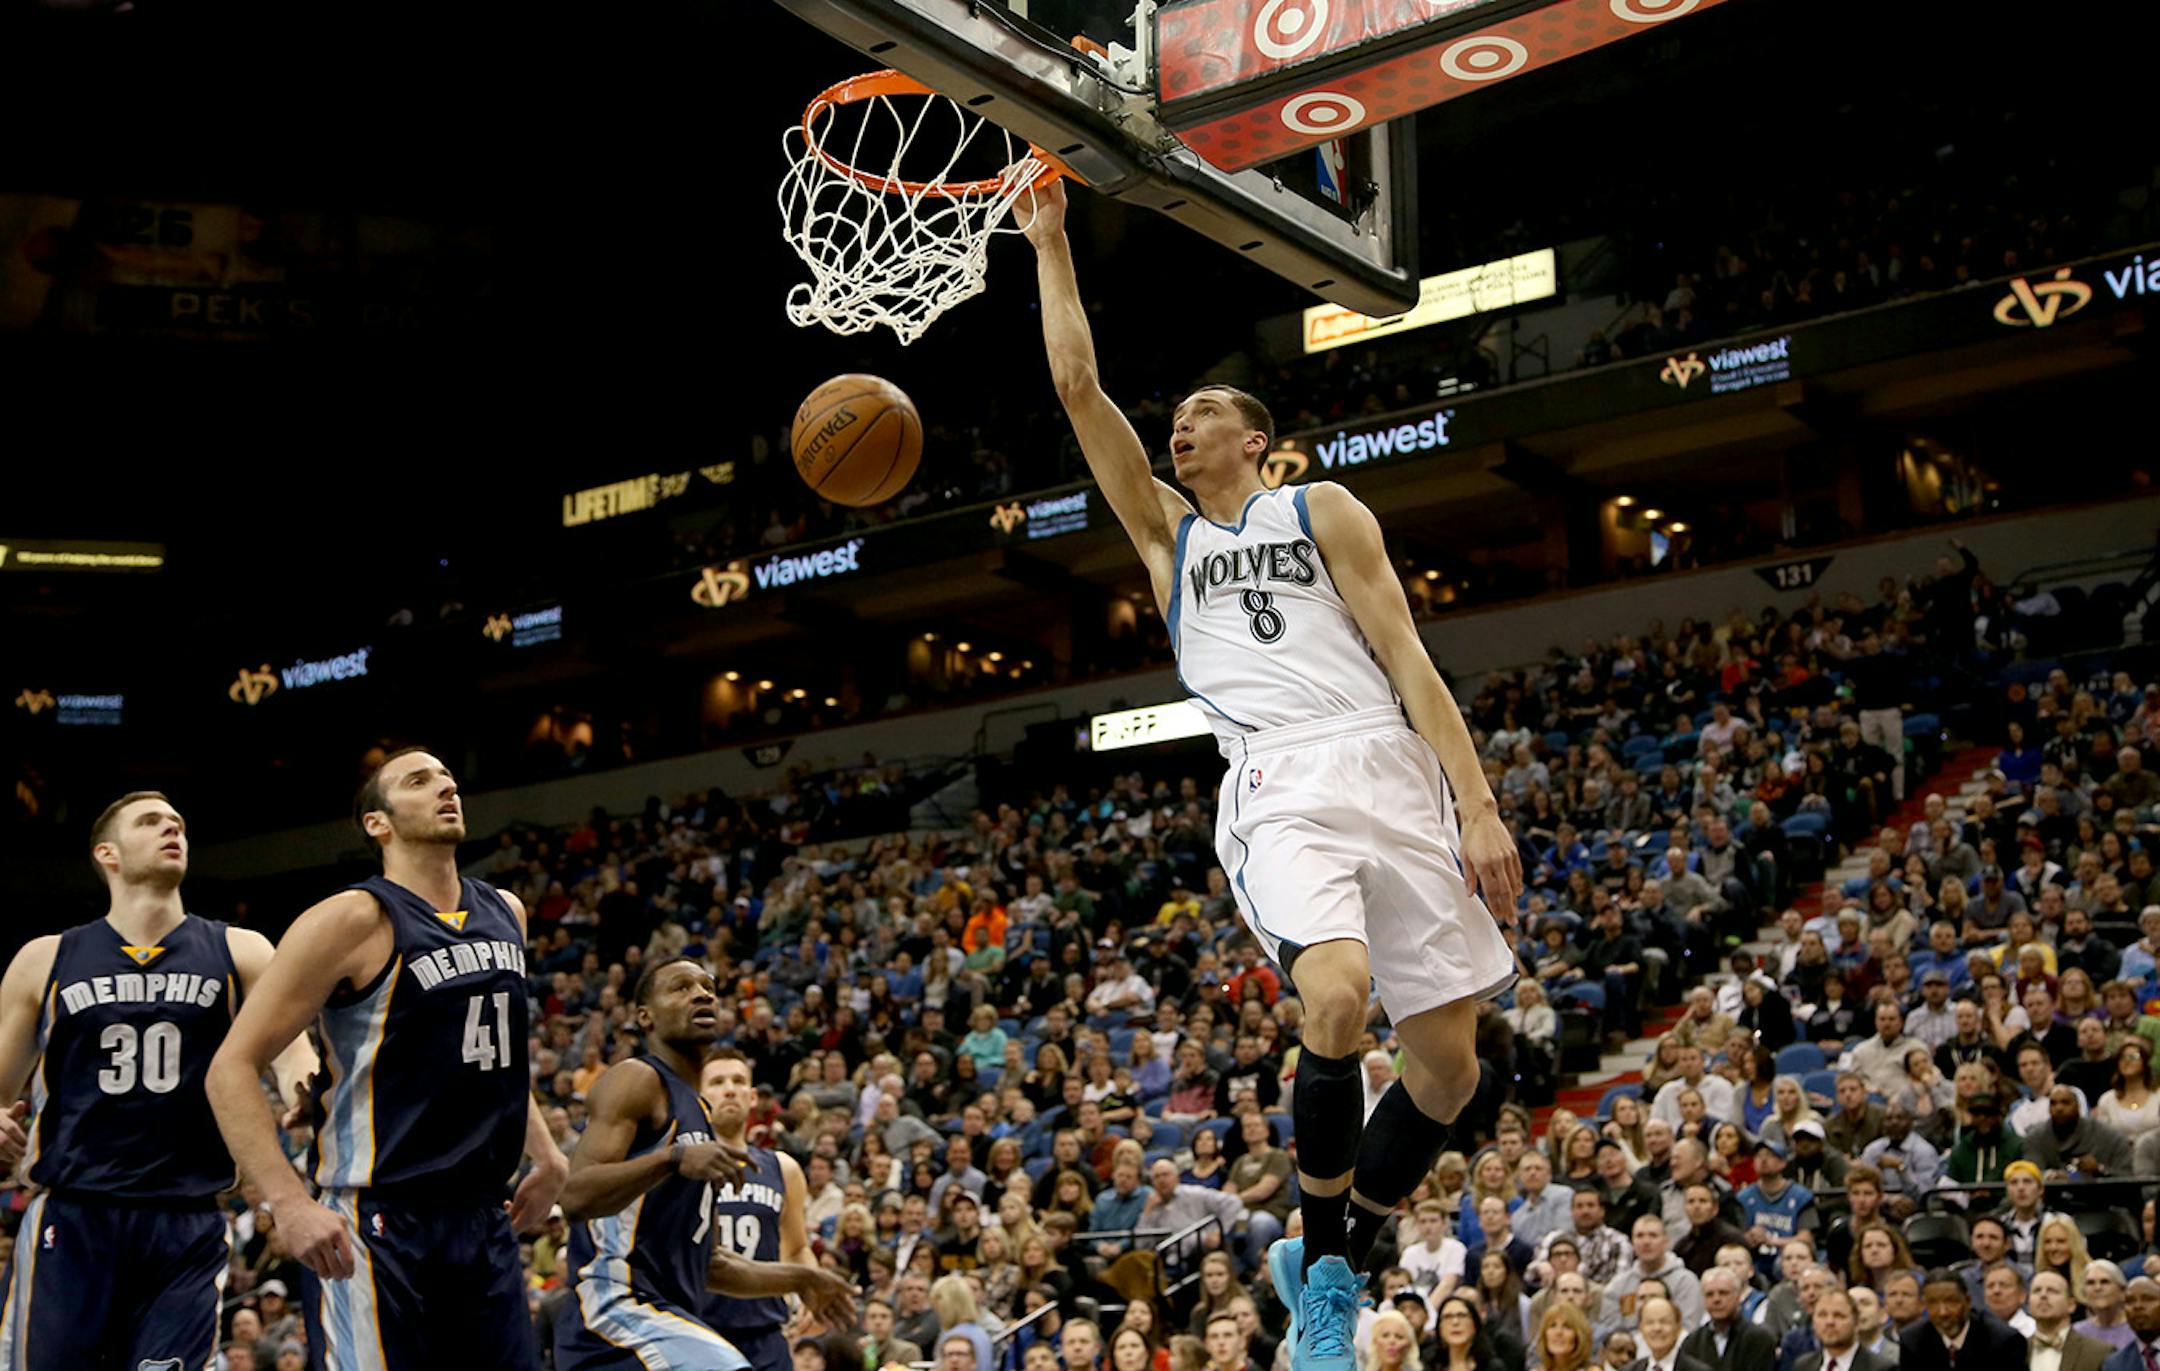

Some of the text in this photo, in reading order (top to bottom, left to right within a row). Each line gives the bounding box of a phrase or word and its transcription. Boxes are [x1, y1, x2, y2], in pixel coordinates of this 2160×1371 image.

[1707, 336, 1790, 372] viawest
[1316, 411, 1451, 470] viawest
[1026, 491, 1088, 520] viawest
[754, 539, 861, 590] viawest
[1189, 539, 1317, 614] WOLVES
[1776, 562, 1812, 588] 131
[1240, 588, 1286, 644] 8
[281, 646, 370, 690] viawest
[60, 973, 222, 1015] MEMPHIS
[461, 992, 511, 1071] 41
[98, 1021, 182, 1095] 30
[718, 1214, 761, 1261] 19
